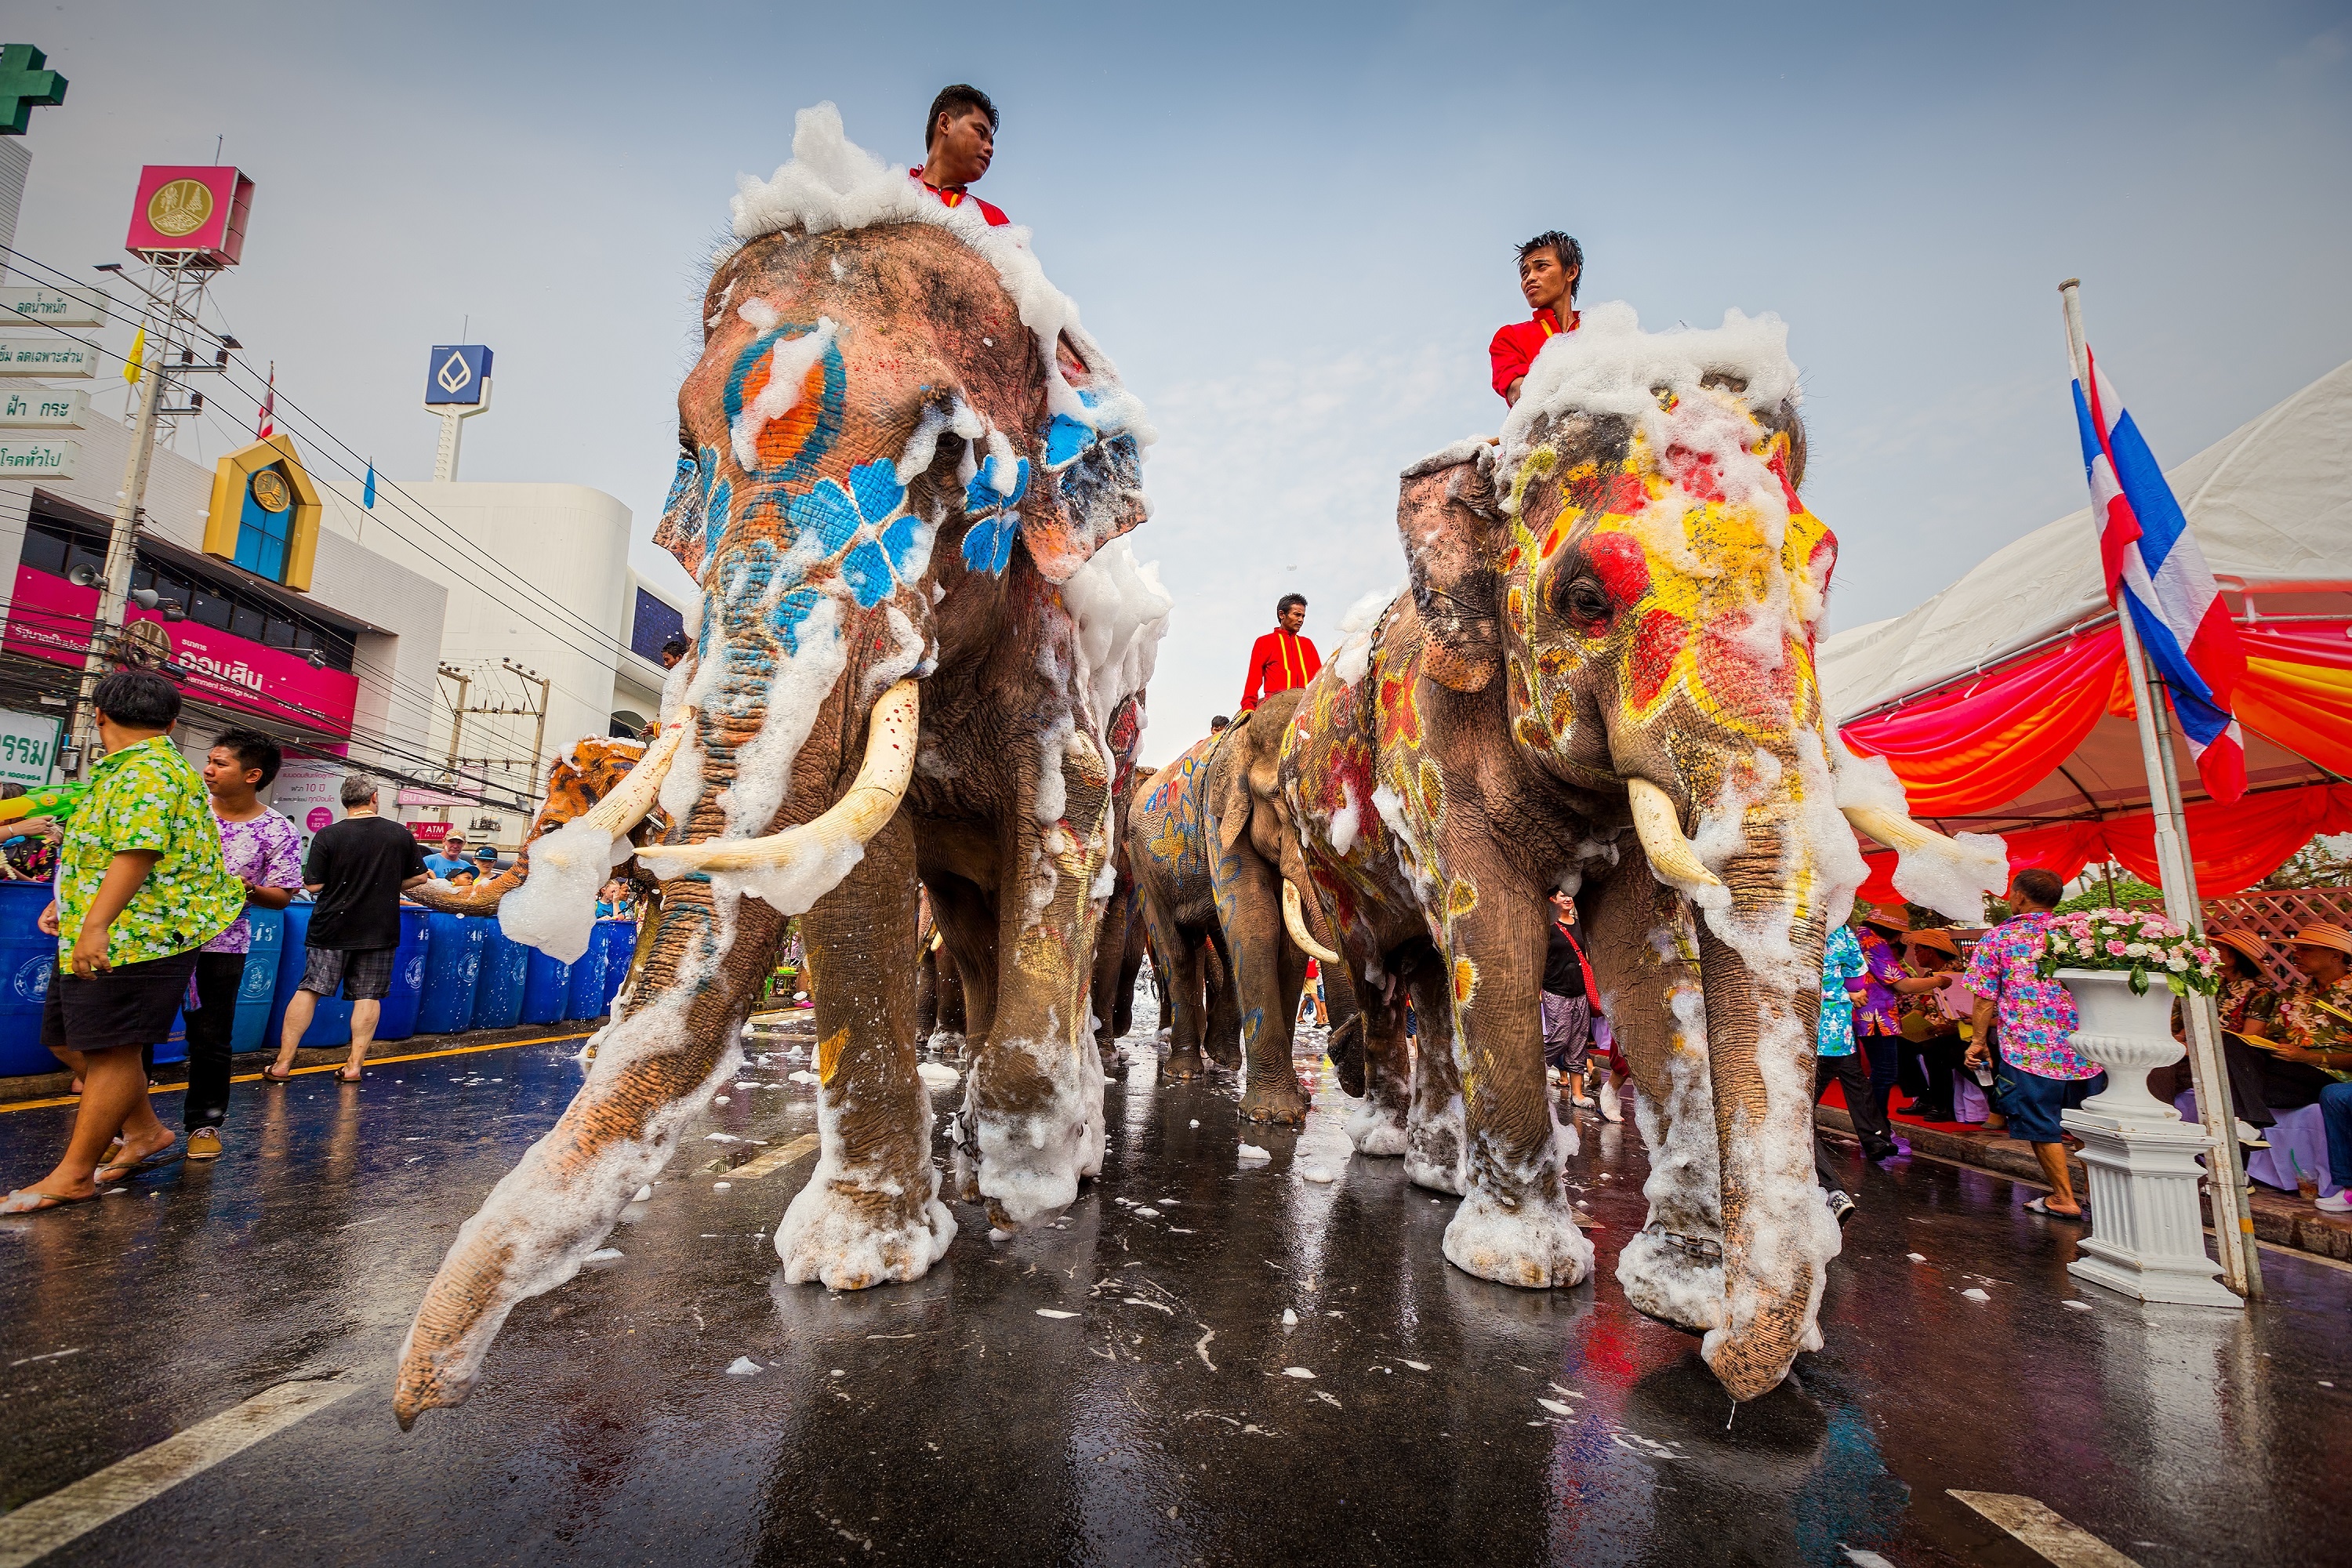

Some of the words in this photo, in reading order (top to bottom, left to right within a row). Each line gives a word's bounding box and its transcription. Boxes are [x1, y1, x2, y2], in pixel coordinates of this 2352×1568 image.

[17, 292, 67, 314] ลดน้ำหนัก
[16, 348, 84, 363] ลดเฉพาะส่วน
[6, 394, 27, 416] ฝ้า
[40, 402, 69, 416] กระ
[0, 446, 62, 466] โรคทั่วไป
[181, 638, 208, 652] ธนาคาร
[178, 651, 263, 691] ออมสิน
[185, 675, 219, 690] vernment
[219, 684, 243, 697] Savings
[0, 734, 49, 767] รรม
[8, 771, 42, 781] 1000954
[306, 783, 317, 792] 10
[319, 783, 326, 792] ปี
[251, 927, 273, 942] 43
[417, 928, 430, 941] 45
[470, 930, 482, 942] 46
[628, 935, 637, 945] 50
